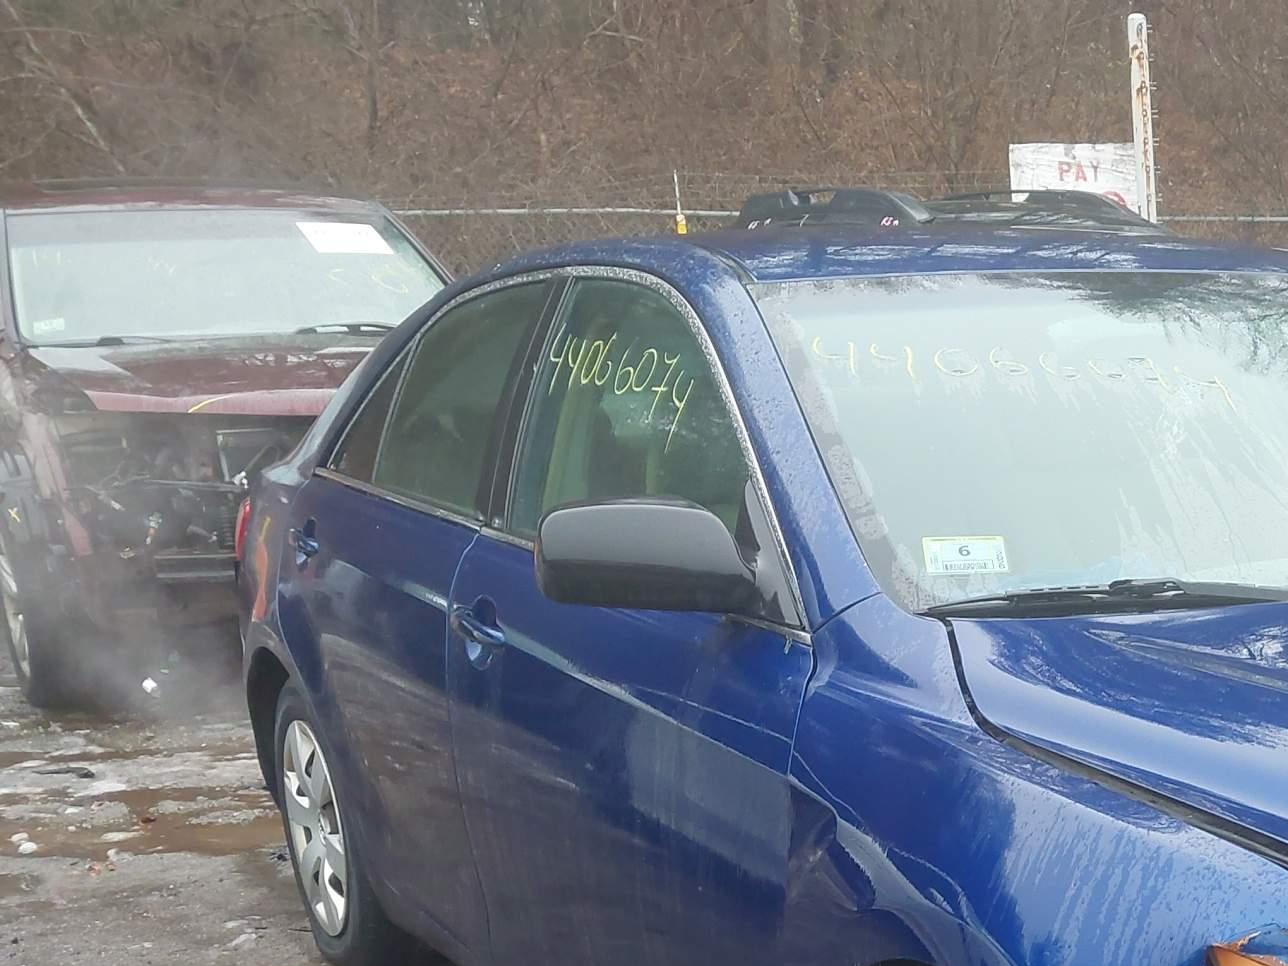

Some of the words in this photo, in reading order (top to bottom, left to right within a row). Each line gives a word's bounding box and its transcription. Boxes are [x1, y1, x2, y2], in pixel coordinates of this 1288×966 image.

[1057, 160, 1100, 182] PAY
[549, 322, 695, 455] 44066074
[958, 545, 971, 557] 6
